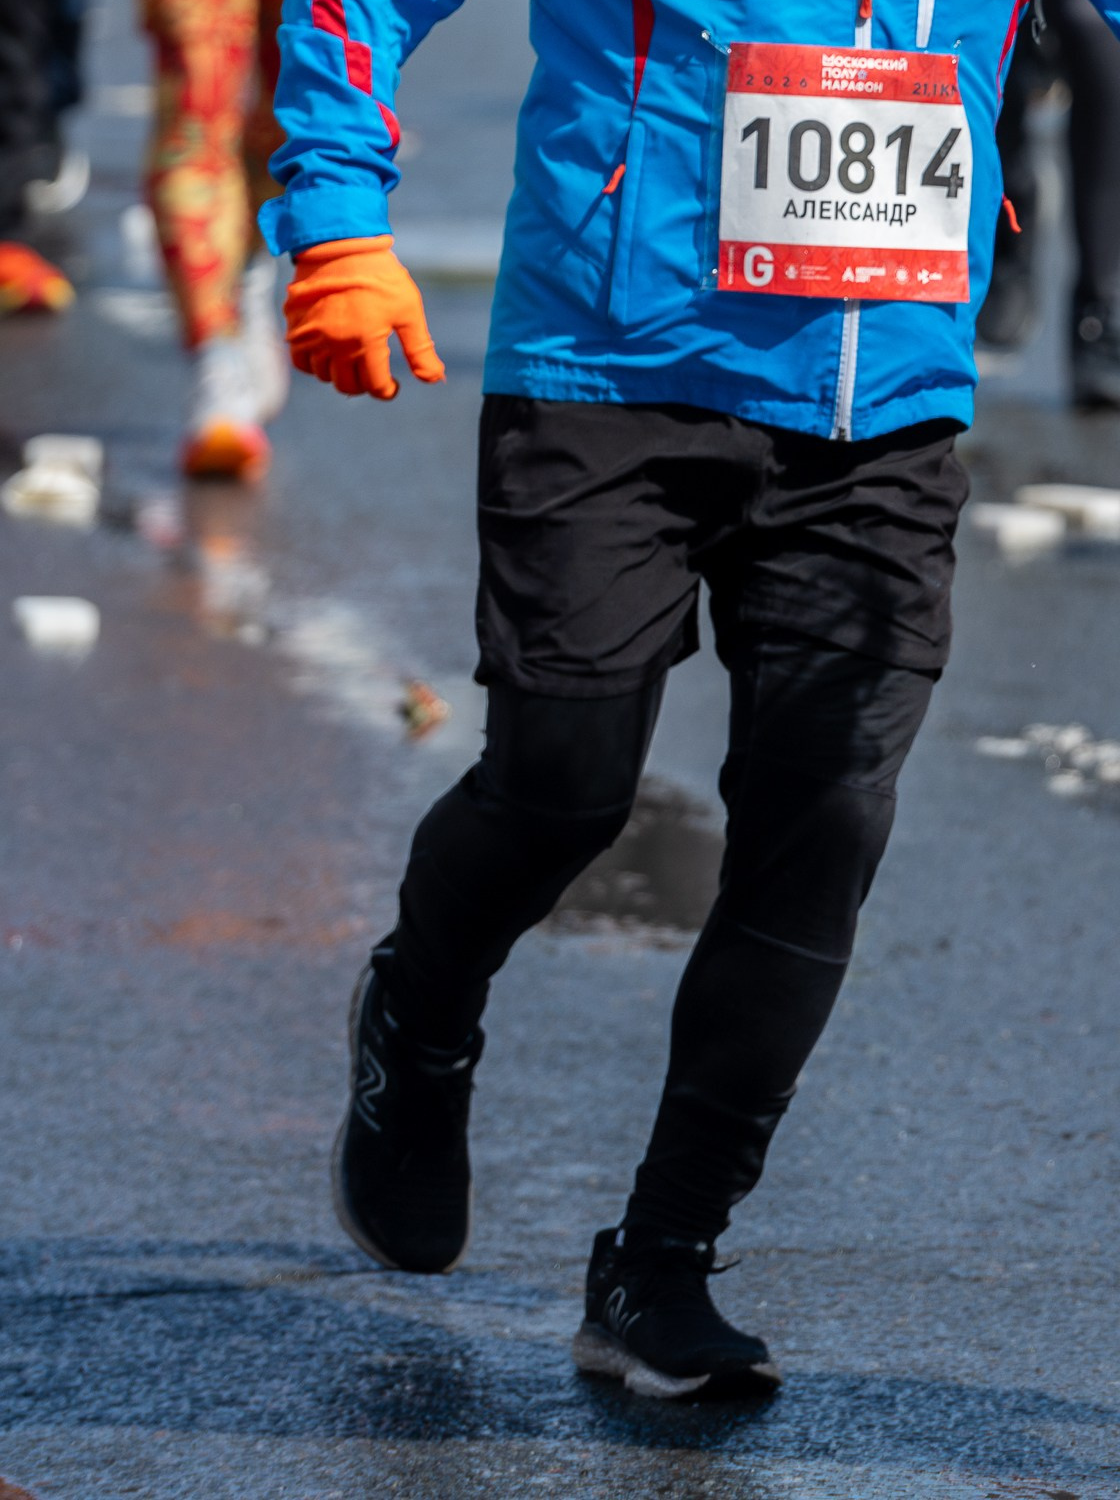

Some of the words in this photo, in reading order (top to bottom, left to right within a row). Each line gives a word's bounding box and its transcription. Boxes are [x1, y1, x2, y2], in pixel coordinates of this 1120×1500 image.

[820, 80, 884, 94] МАРАФОН
[821, 67, 858, 80] ПОЛУ
[740, 116, 965, 199] 10814
[783, 199, 918, 227] АЛЕКСАНДР
[743, 246, 775, 288] G
